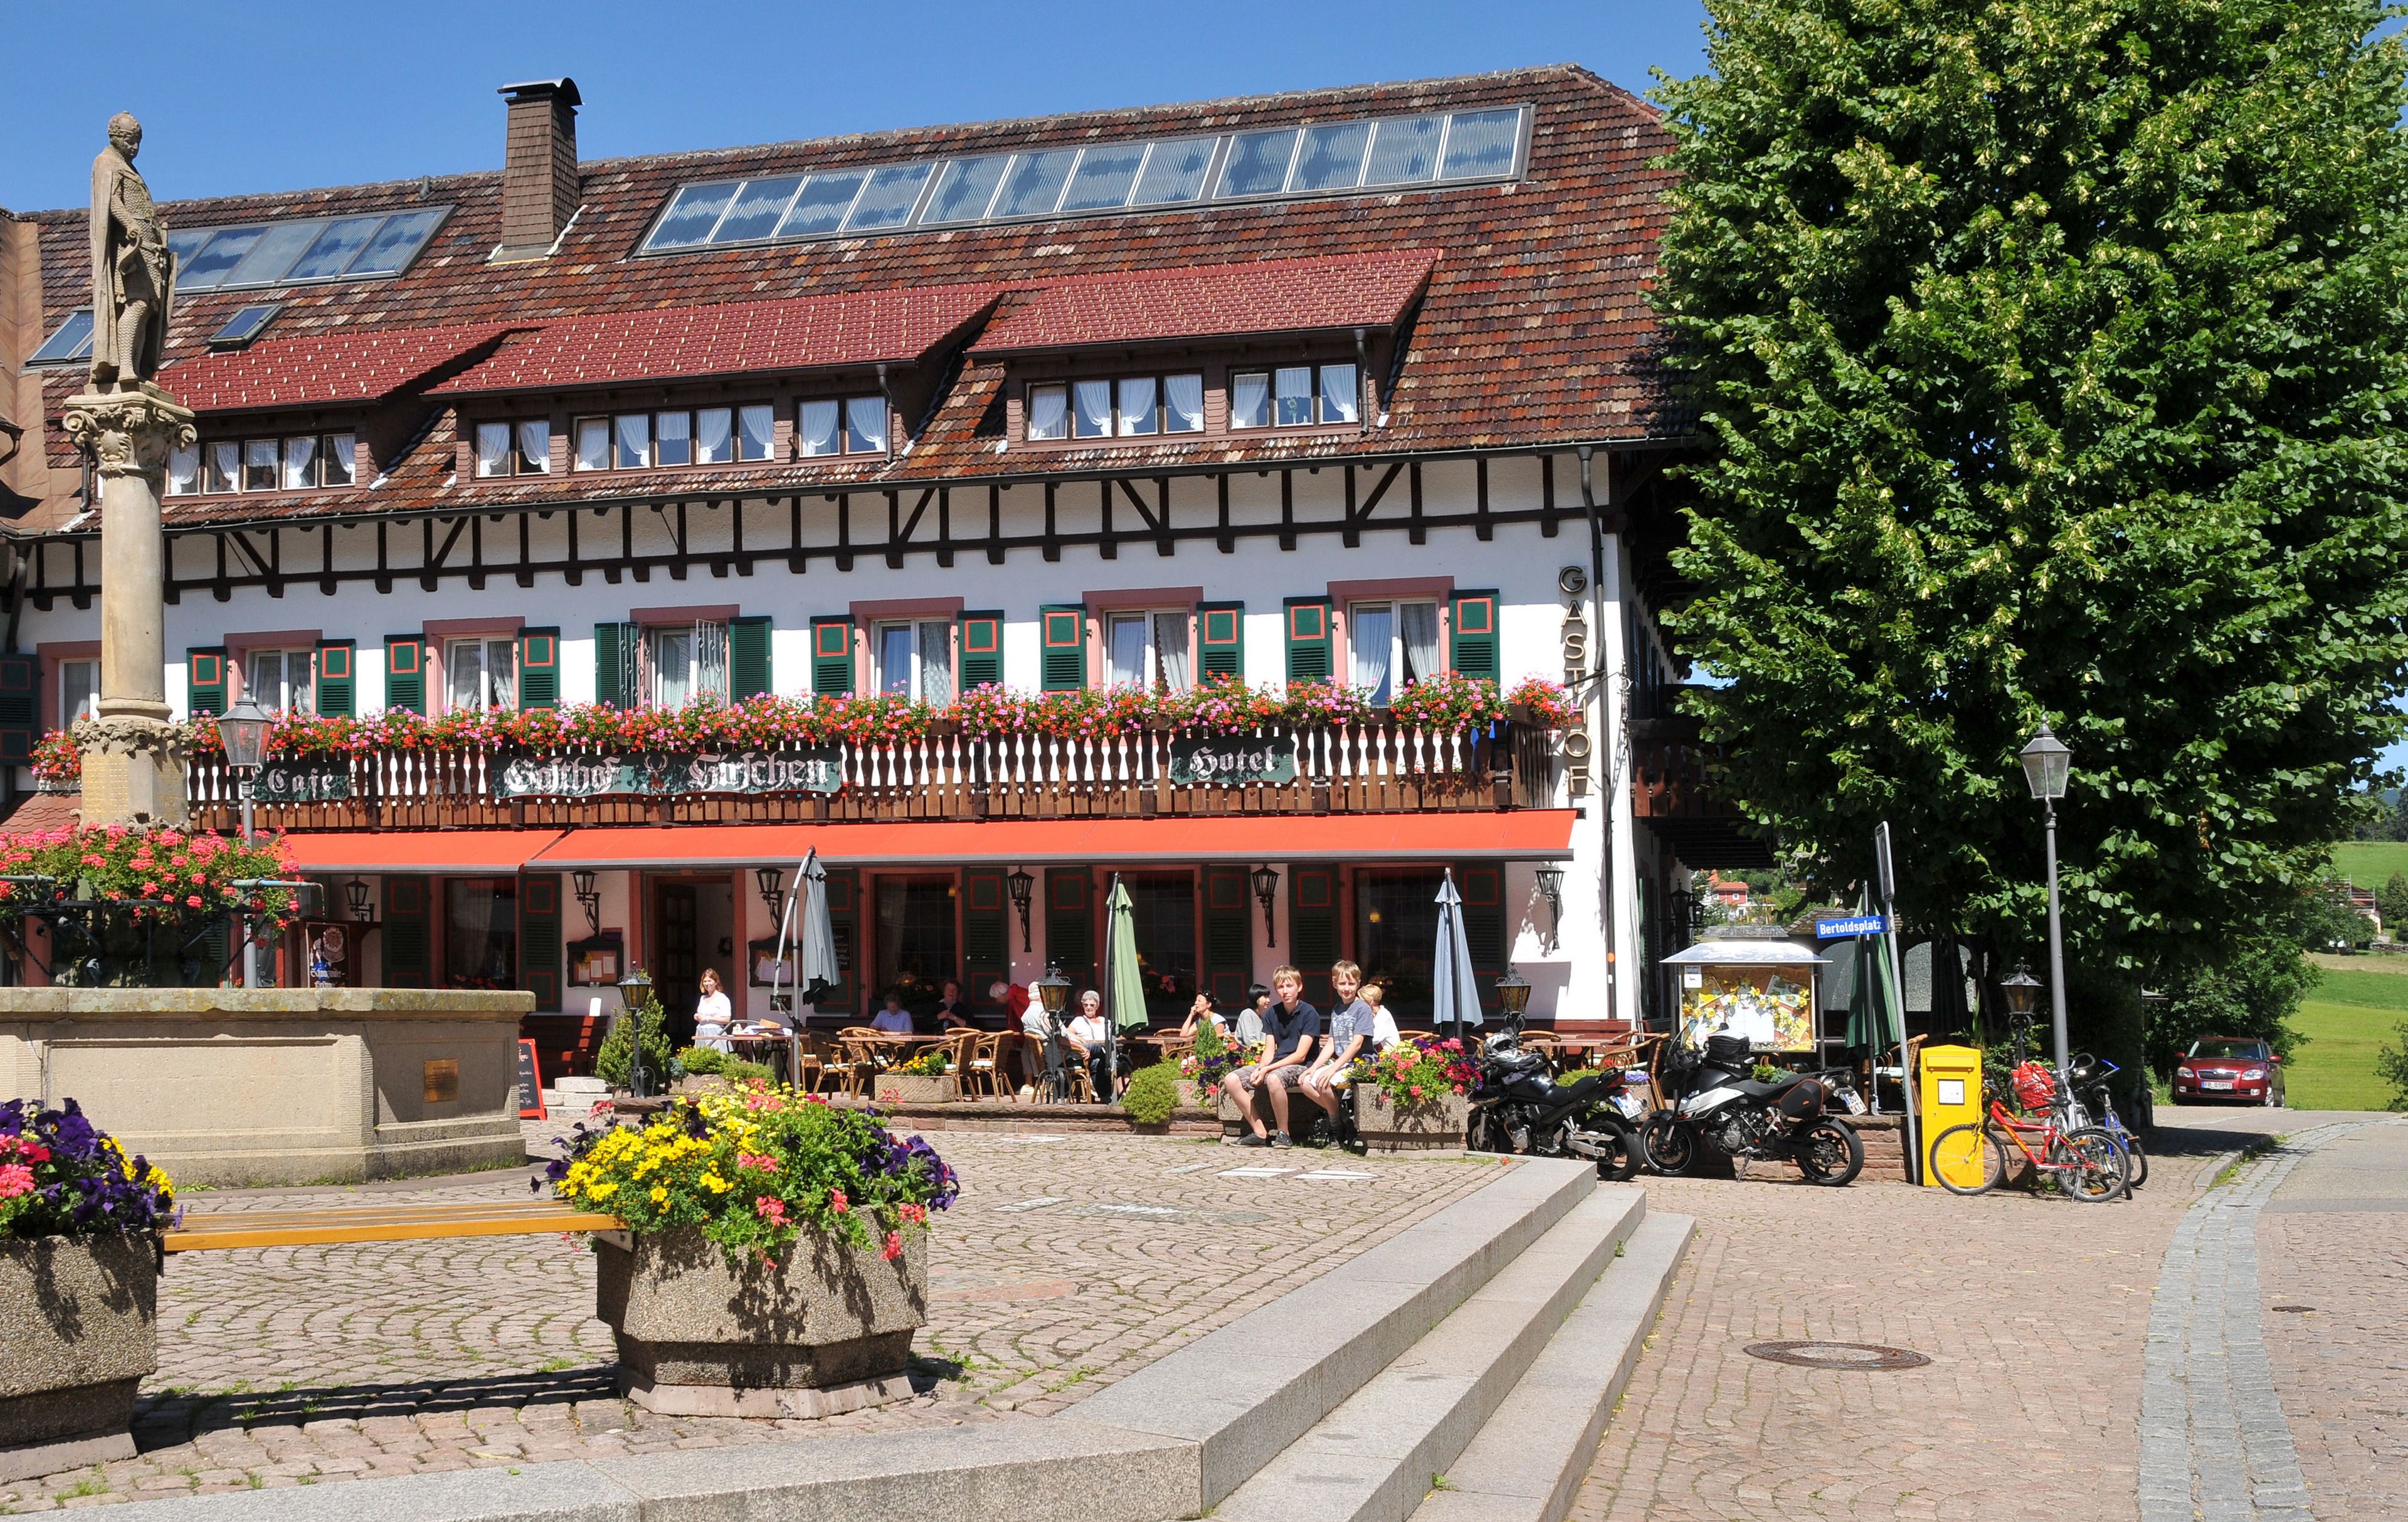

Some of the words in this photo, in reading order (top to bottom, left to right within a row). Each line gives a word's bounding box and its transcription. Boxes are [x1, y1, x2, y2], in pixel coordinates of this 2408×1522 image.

[1558, 566, 1592, 795] GASTHOF
[1190, 744, 1275, 781] Hotel
[267, 768, 333, 798] Café
[1820, 919, 1882, 935] Bertoldsplatz
